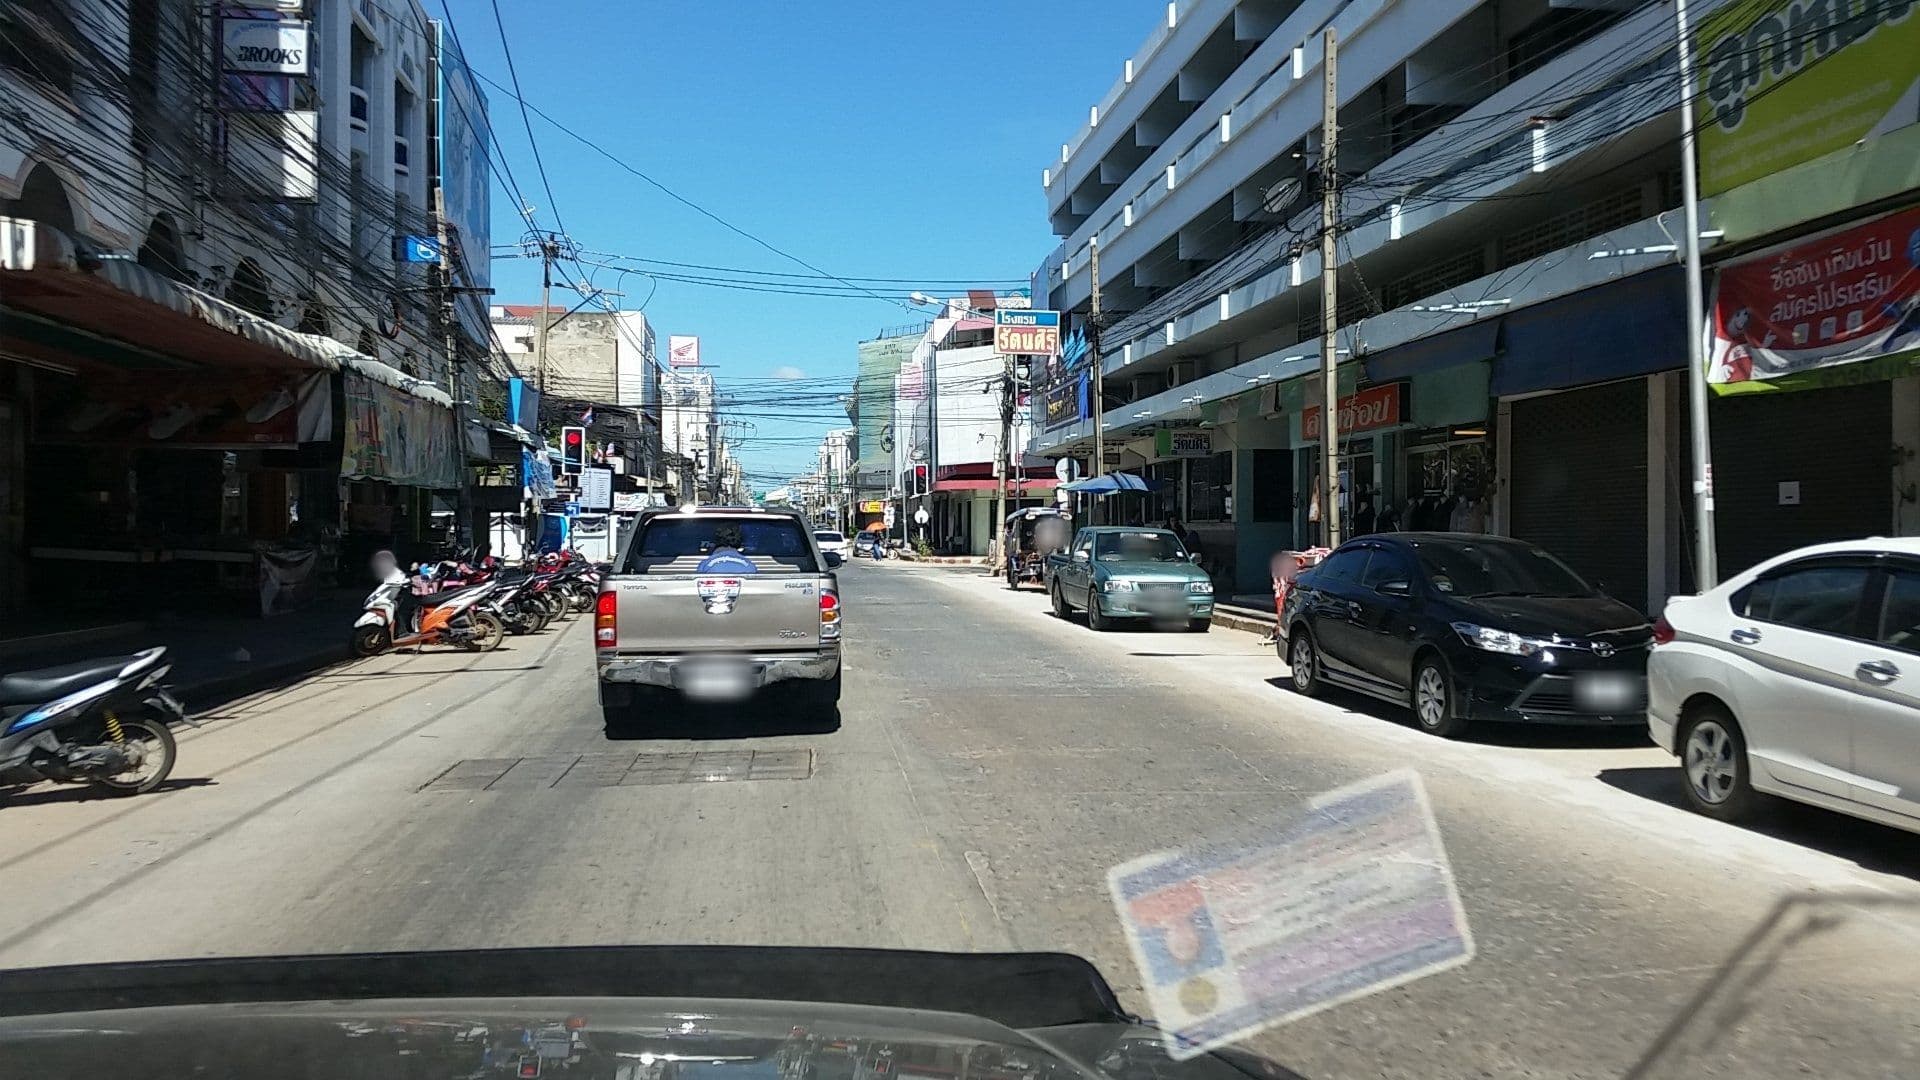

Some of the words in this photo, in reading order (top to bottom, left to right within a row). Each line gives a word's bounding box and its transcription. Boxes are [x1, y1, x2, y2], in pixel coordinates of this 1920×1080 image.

[237, 45, 303, 65] BROOKS
[1000, 310, 1036, 325] โรงแรม
